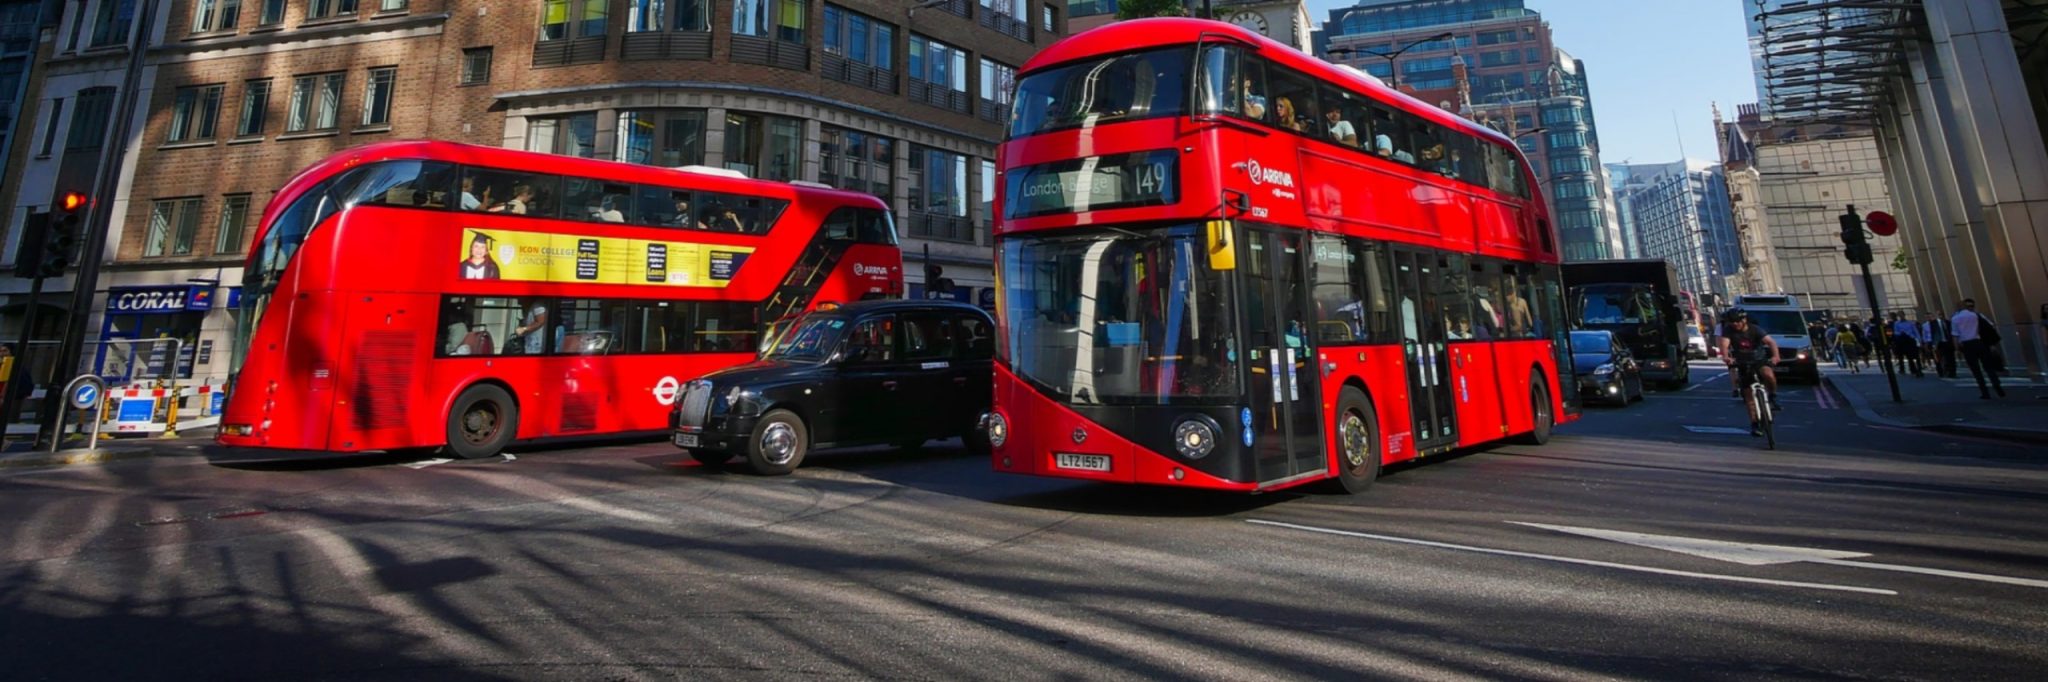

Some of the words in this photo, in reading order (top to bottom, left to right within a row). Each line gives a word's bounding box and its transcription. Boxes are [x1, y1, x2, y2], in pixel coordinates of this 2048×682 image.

[1135, 162, 1166, 195] 149
[1263, 167, 1295, 188] ARRIVA
[1023, 178, 1065, 197] London
[1069, 176, 1108, 194] Bge
[519, 246, 539, 254] ICON
[541, 247, 577, 256] COLLEGE
[518, 257, 554, 266] LONDON
[864, 266, 888, 275] ARRIVA
[117, 291, 185, 310] CORAL
[1061, 455, 1104, 469] LTZ1567
